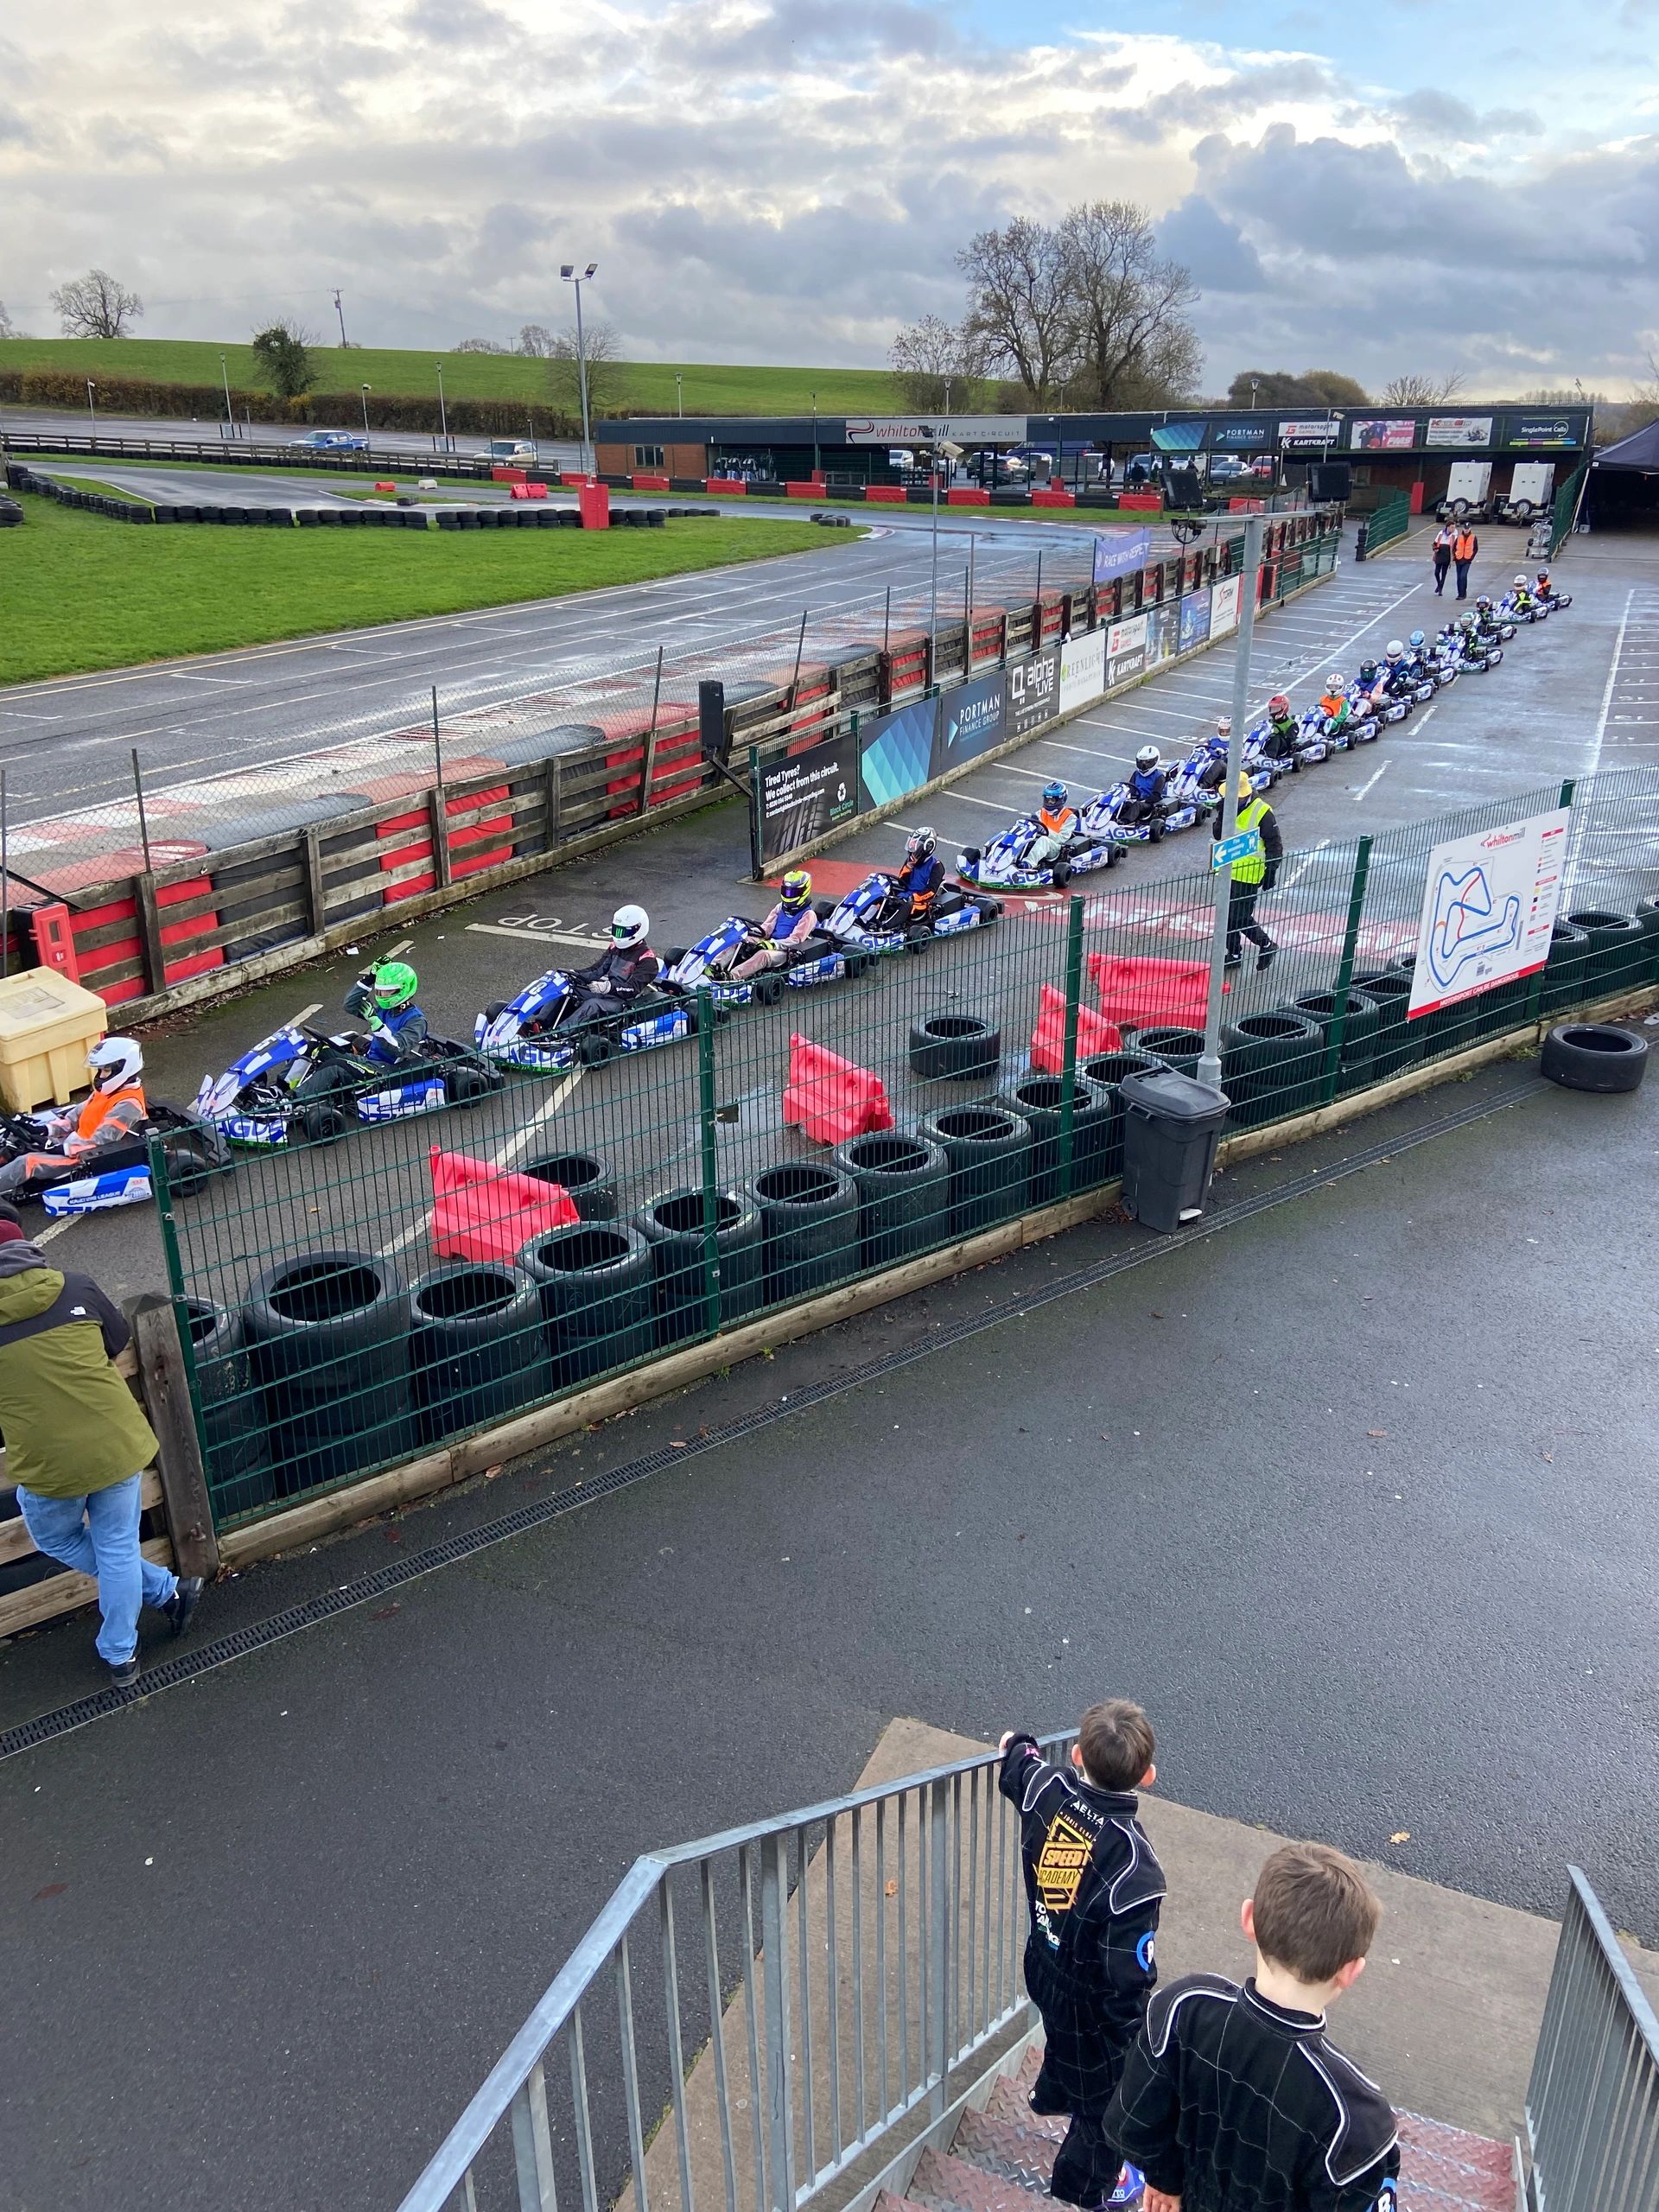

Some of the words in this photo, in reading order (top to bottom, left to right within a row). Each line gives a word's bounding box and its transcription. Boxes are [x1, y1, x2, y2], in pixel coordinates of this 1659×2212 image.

[1027, 657, 1054, 689] alpha
[1037, 677, 1054, 697] LIVE
[960, 693, 1001, 725] PORTMAN
[959, 719, 982, 736] FINANCE
[982, 710, 1000, 726] GROUP
[765, 772, 780, 788] Tired
[781, 764, 800, 784] Tyres?
[766, 789, 775, 801] We
[776, 780, 796, 797] collect
[796, 777, 810, 788] from
[810, 769, 820, 782] this
[821, 762, 839, 778] circuit.
[1486, 826, 1526, 848] whiltonmill
[1439, 988, 1472, 1007] MOTORSPORT
[1472, 985, 1482, 995] CAN
[1482, 982, 1491, 991] BE
[1491, 972, 1520, 989] DANGEROUS
[68, 1195, 97, 1205] KARTING
[98, 1191, 121, 1200] LEAGUE
[1043, 1848, 1084, 1866] SPEED
